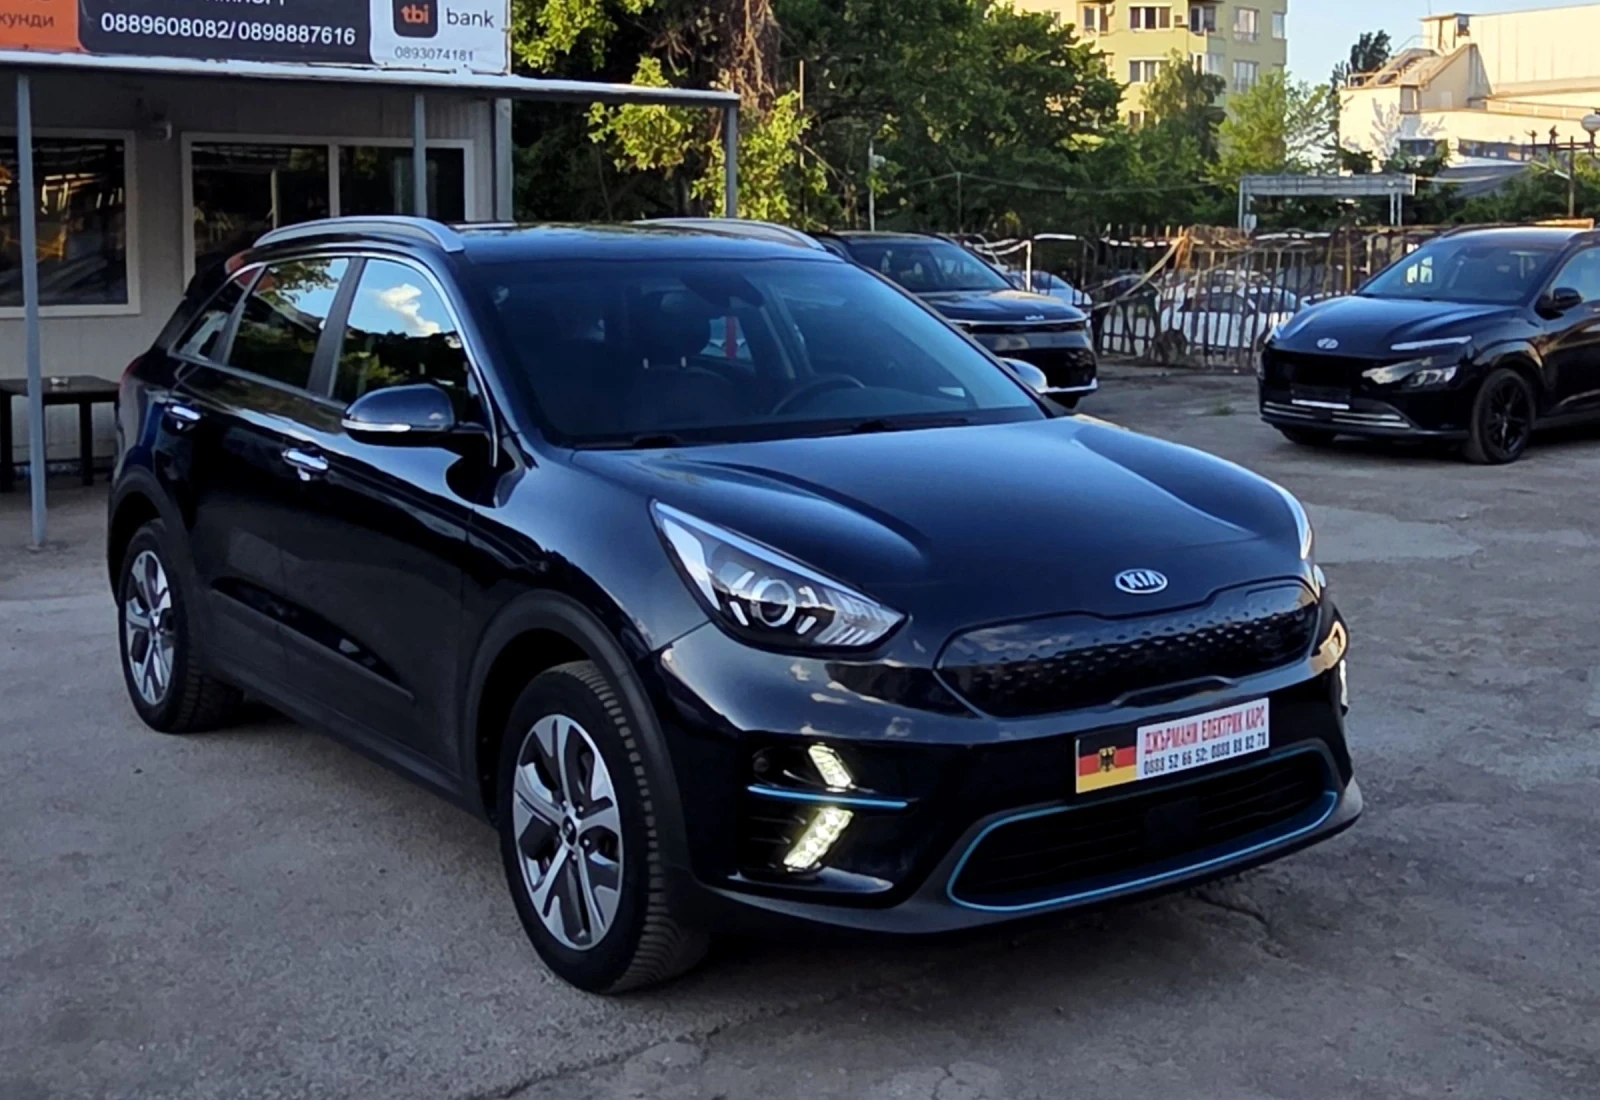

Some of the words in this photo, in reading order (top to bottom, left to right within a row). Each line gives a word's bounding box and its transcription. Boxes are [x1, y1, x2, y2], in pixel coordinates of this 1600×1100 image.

[401, 5, 429, 24] tbi
[446, 7, 495, 28] bank
[100, 12, 357, 46] 0889608082/0898887616
[394, 45, 474, 62] 0893074181
[1121, 570, 1163, 589] KIA
